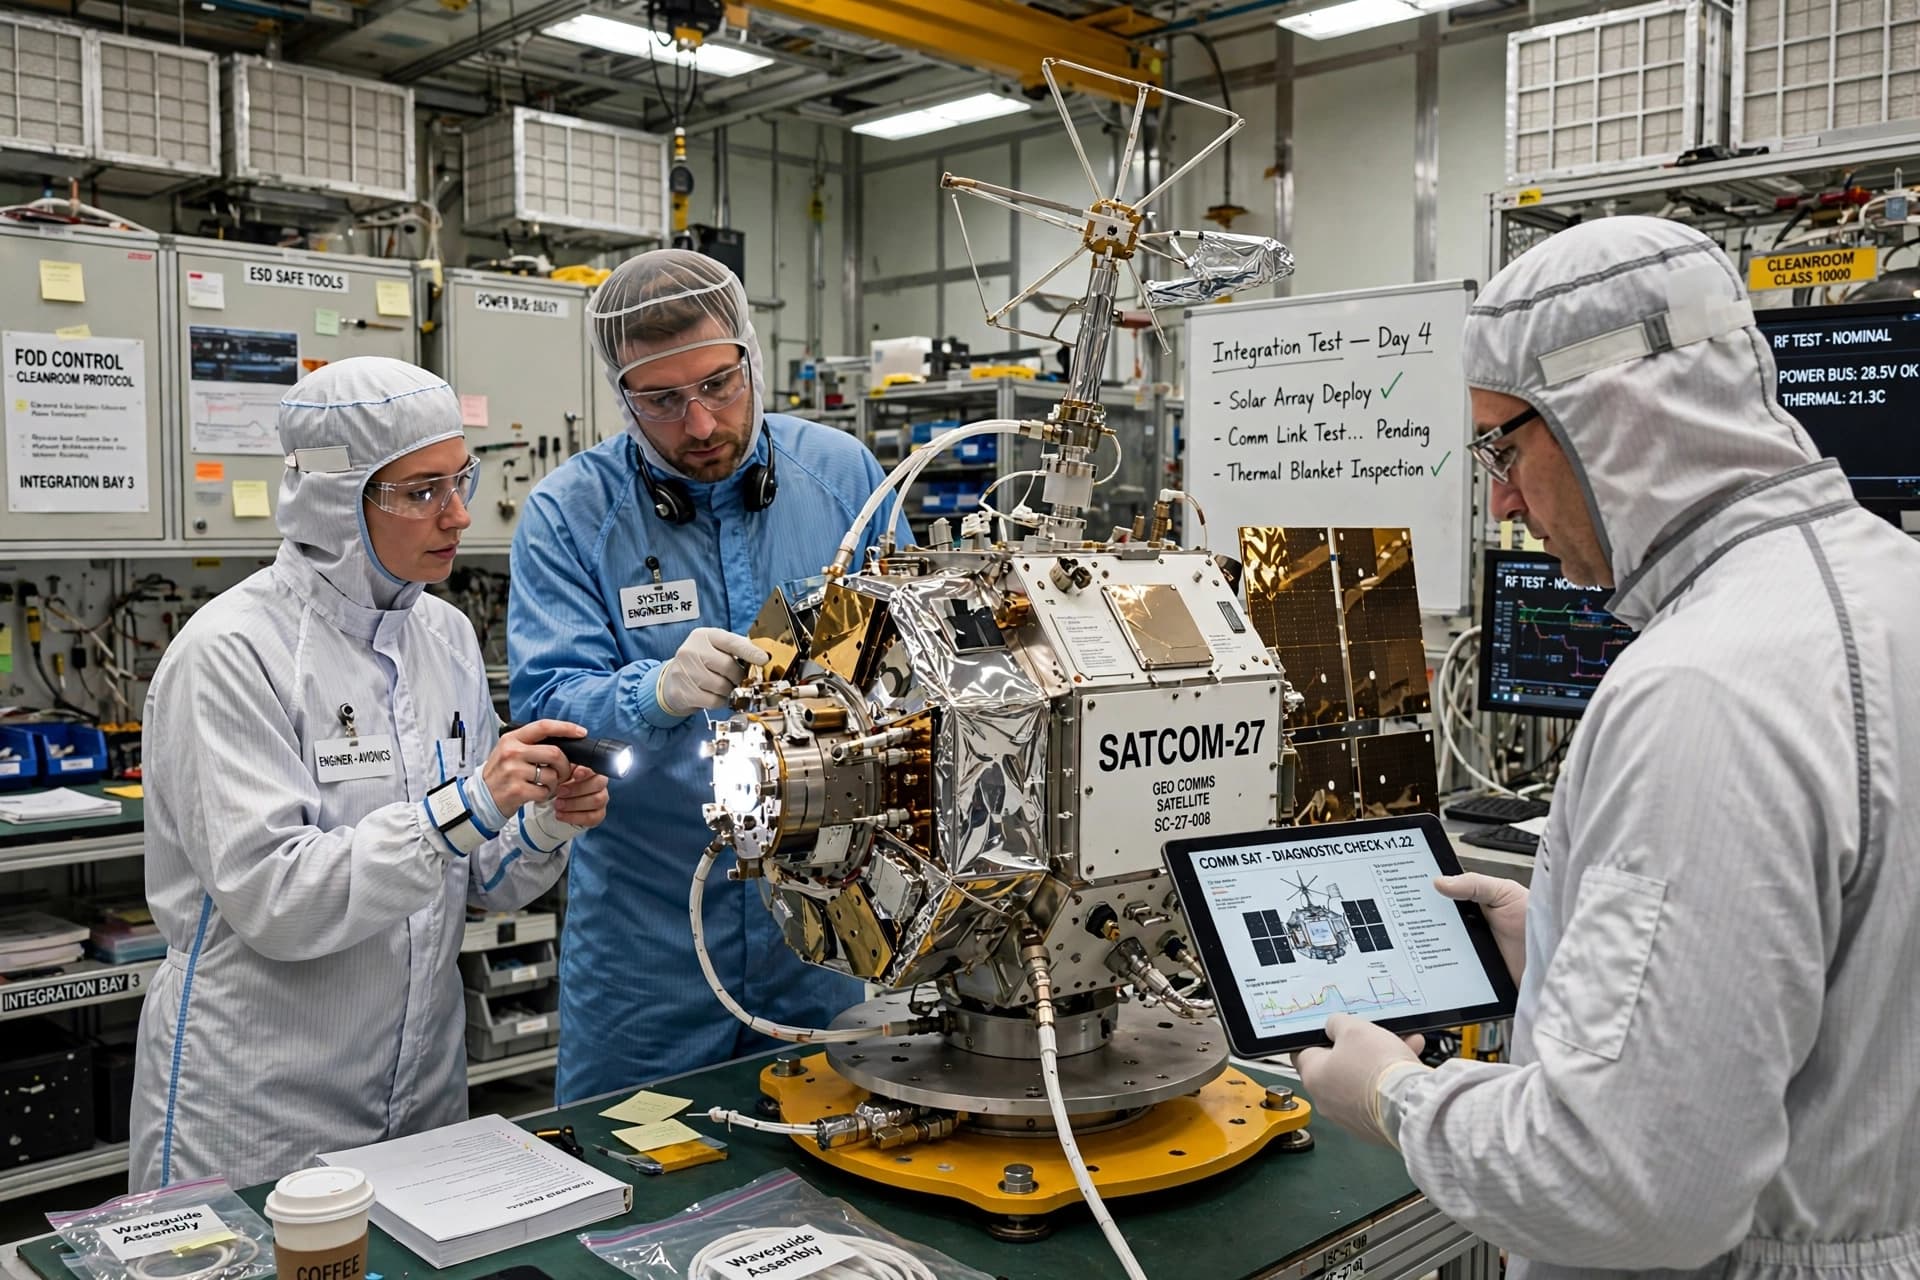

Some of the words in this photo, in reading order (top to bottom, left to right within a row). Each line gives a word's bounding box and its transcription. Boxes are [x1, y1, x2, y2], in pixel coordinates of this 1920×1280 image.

[1767, 252, 1854, 271] CLEANROOM
[250, 266, 273, 282] ESD
[275, 269, 304, 285] SAFE
[306, 273, 344, 289] TOOLS
[1774, 272, 1813, 286] CLASS
[1817, 268, 1851, 282] 10000
[1212, 337, 1302, 369] Integration
[1307, 330, 1344, 352] Test
[1378, 326, 1410, 355] Day
[1418, 321, 1433, 345] 4
[1774, 335, 1789, 348] RF
[1792, 332, 1823, 347] TEST
[1832, 328, 1893, 345] NOMINAL
[15, 348, 48, 367] FOD
[51, 351, 124, 371] CONTROL
[16, 371, 80, 385] CLEANROOM
[83, 374, 135, 388] PROTOCOL
[1779, 368, 1825, 384] POWER
[1828, 367, 1857, 381] BUS:
[1860, 365, 1897, 380] 28.5V
[1900, 363, 1919, 379] OK
[1229, 389, 1267, 410] Solar
[1273, 387, 1314, 414] Array
[1323, 381, 1372, 410] Deploy
[1782, 392, 1846, 407] THERMAL:
[1849, 389, 1886, 405] 21.3C
[1228, 426, 1268, 446] Comm
[1277, 423, 1307, 444] Link
[1313, 422, 1363, 441] Test...
[1376, 418, 1430, 447] Pending
[20, 475, 99, 489] INTEGRATION
[102, 475, 125, 489] BAY
[127, 476, 135, 489] 3
[1227, 461, 1281, 481] Thermal
[1290, 459, 1343, 481] Blanket
[1350, 458, 1424, 485] Inspection
[1505, 575, 1517, 588] RF
[1520, 576, 1545, 589] TEST
[637, 590, 680, 605] SYSTEMS
[680, 600, 692, 611] RF
[1099, 719, 1266, 772] SATCOM-27
[1153, 780, 1174, 796] GEO
[1177, 775, 1215, 792] COMMS
[1157, 792, 1210, 812] SATELLITE
[1154, 811, 1211, 832] SC-27-008
[1199, 855, 1239, 869] COMM
[1241, 851, 1262, 866] SAT
[1272, 844, 1342, 862] DIAGNOSTIC
[1344, 839, 1384, 854] CHECK
[1385, 836, 1414, 849] v1.22
[4, 979, 96, 1010] INTEGRATION
[99, 975, 125, 993] BAY
[131, 974, 140, 987] 3
[112, 1211, 203, 1235] Waveguide
[123, 1221, 199, 1244] Assembly
[725, 1233, 815, 1268] Waveguide
[747, 1245, 823, 1278] Assembly
[297, 1254, 359, 1280] COFFEE
